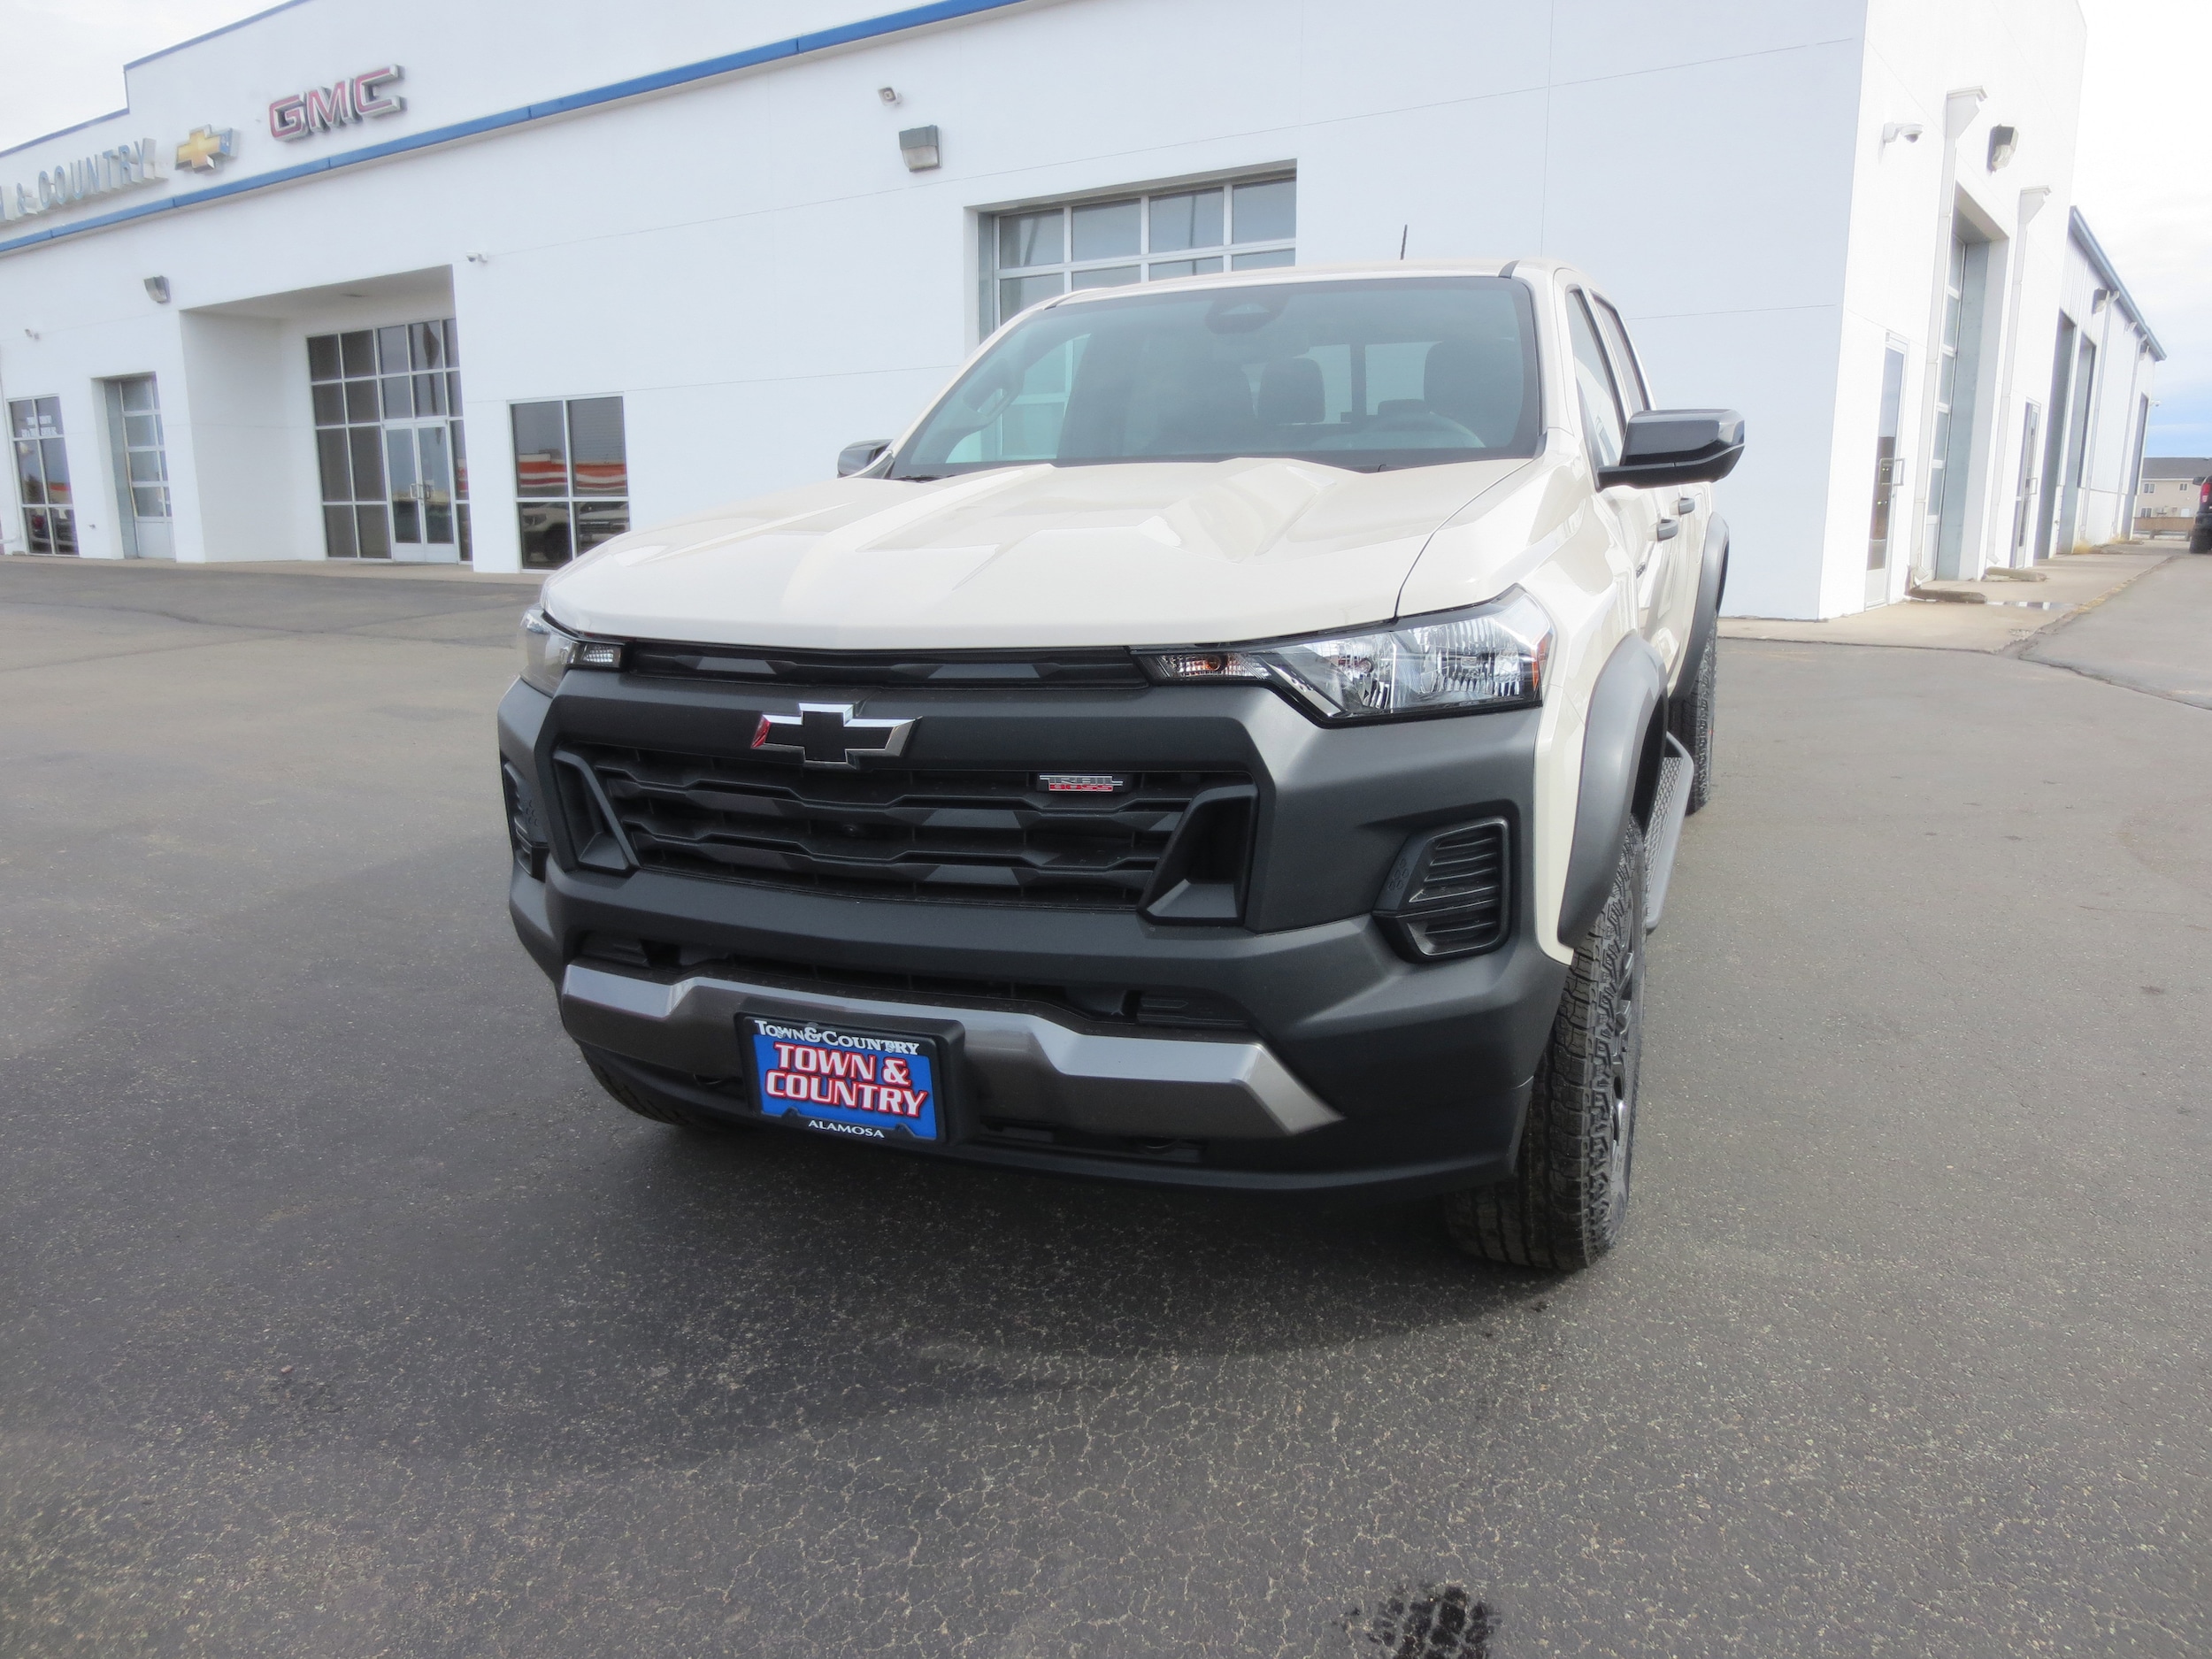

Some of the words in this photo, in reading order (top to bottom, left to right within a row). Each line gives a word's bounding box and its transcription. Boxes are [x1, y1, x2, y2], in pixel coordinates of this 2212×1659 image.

[269, 65, 406, 142] GMC
[38, 138, 157, 211] COUNTRY
[773, 1041, 876, 1081] TOWN
[882, 1057, 911, 1087] &
[765, 1070, 927, 1117] COUNTRY
[808, 1119, 885, 1139] ALAMOSA
